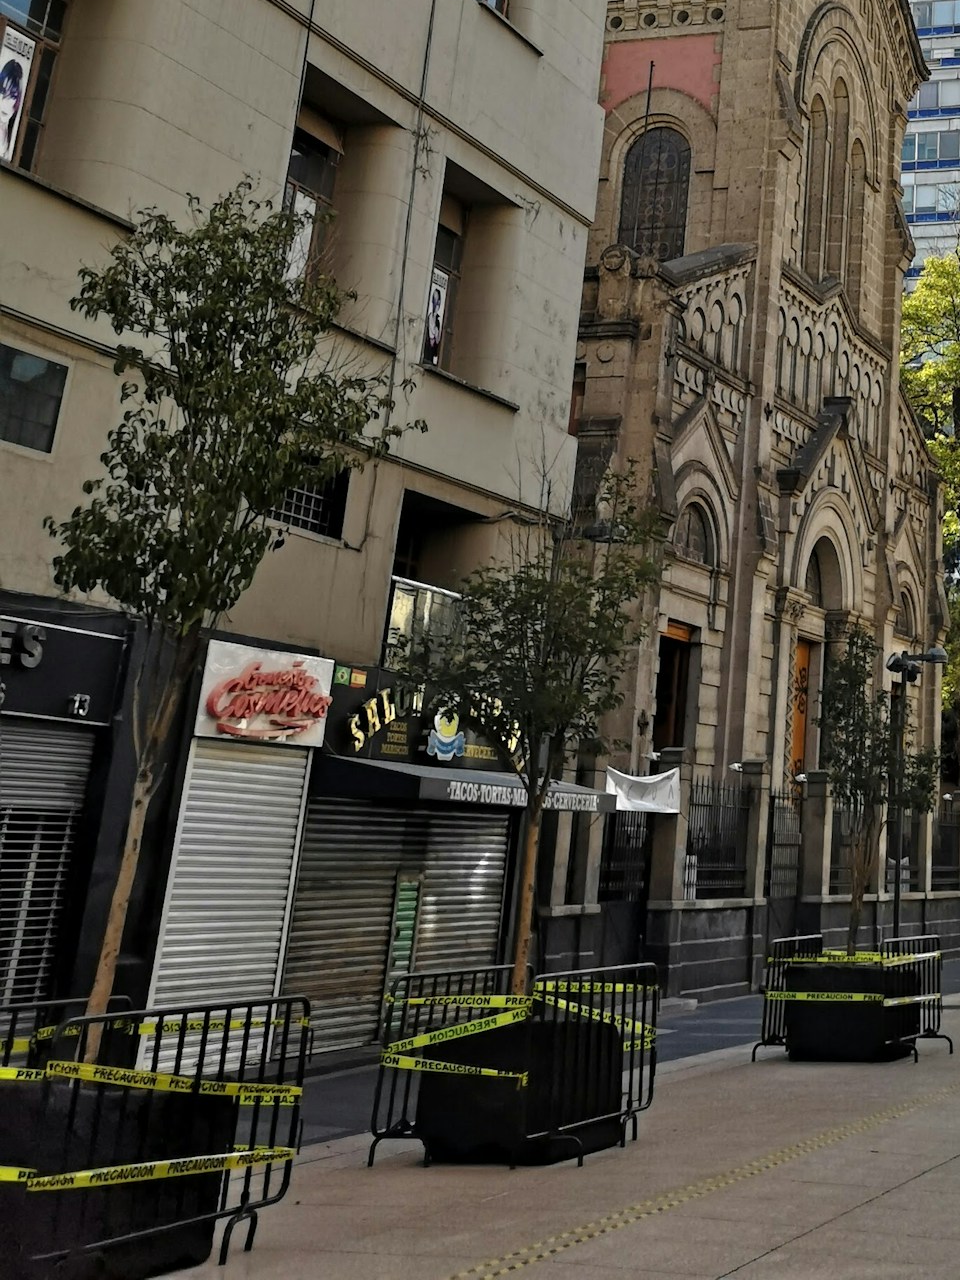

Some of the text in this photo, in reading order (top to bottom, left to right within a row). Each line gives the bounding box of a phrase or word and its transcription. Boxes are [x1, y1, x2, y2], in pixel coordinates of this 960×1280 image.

[805, 992, 853, 1000] PRECAUCION
[414, 1059, 482, 1075] PRECAUCION
[93, 1067, 157, 1087] PRECAUCION
[89, 1165, 156, 1184] PRECAUCION
[167, 1157, 228, 1174] PRECAUCION
